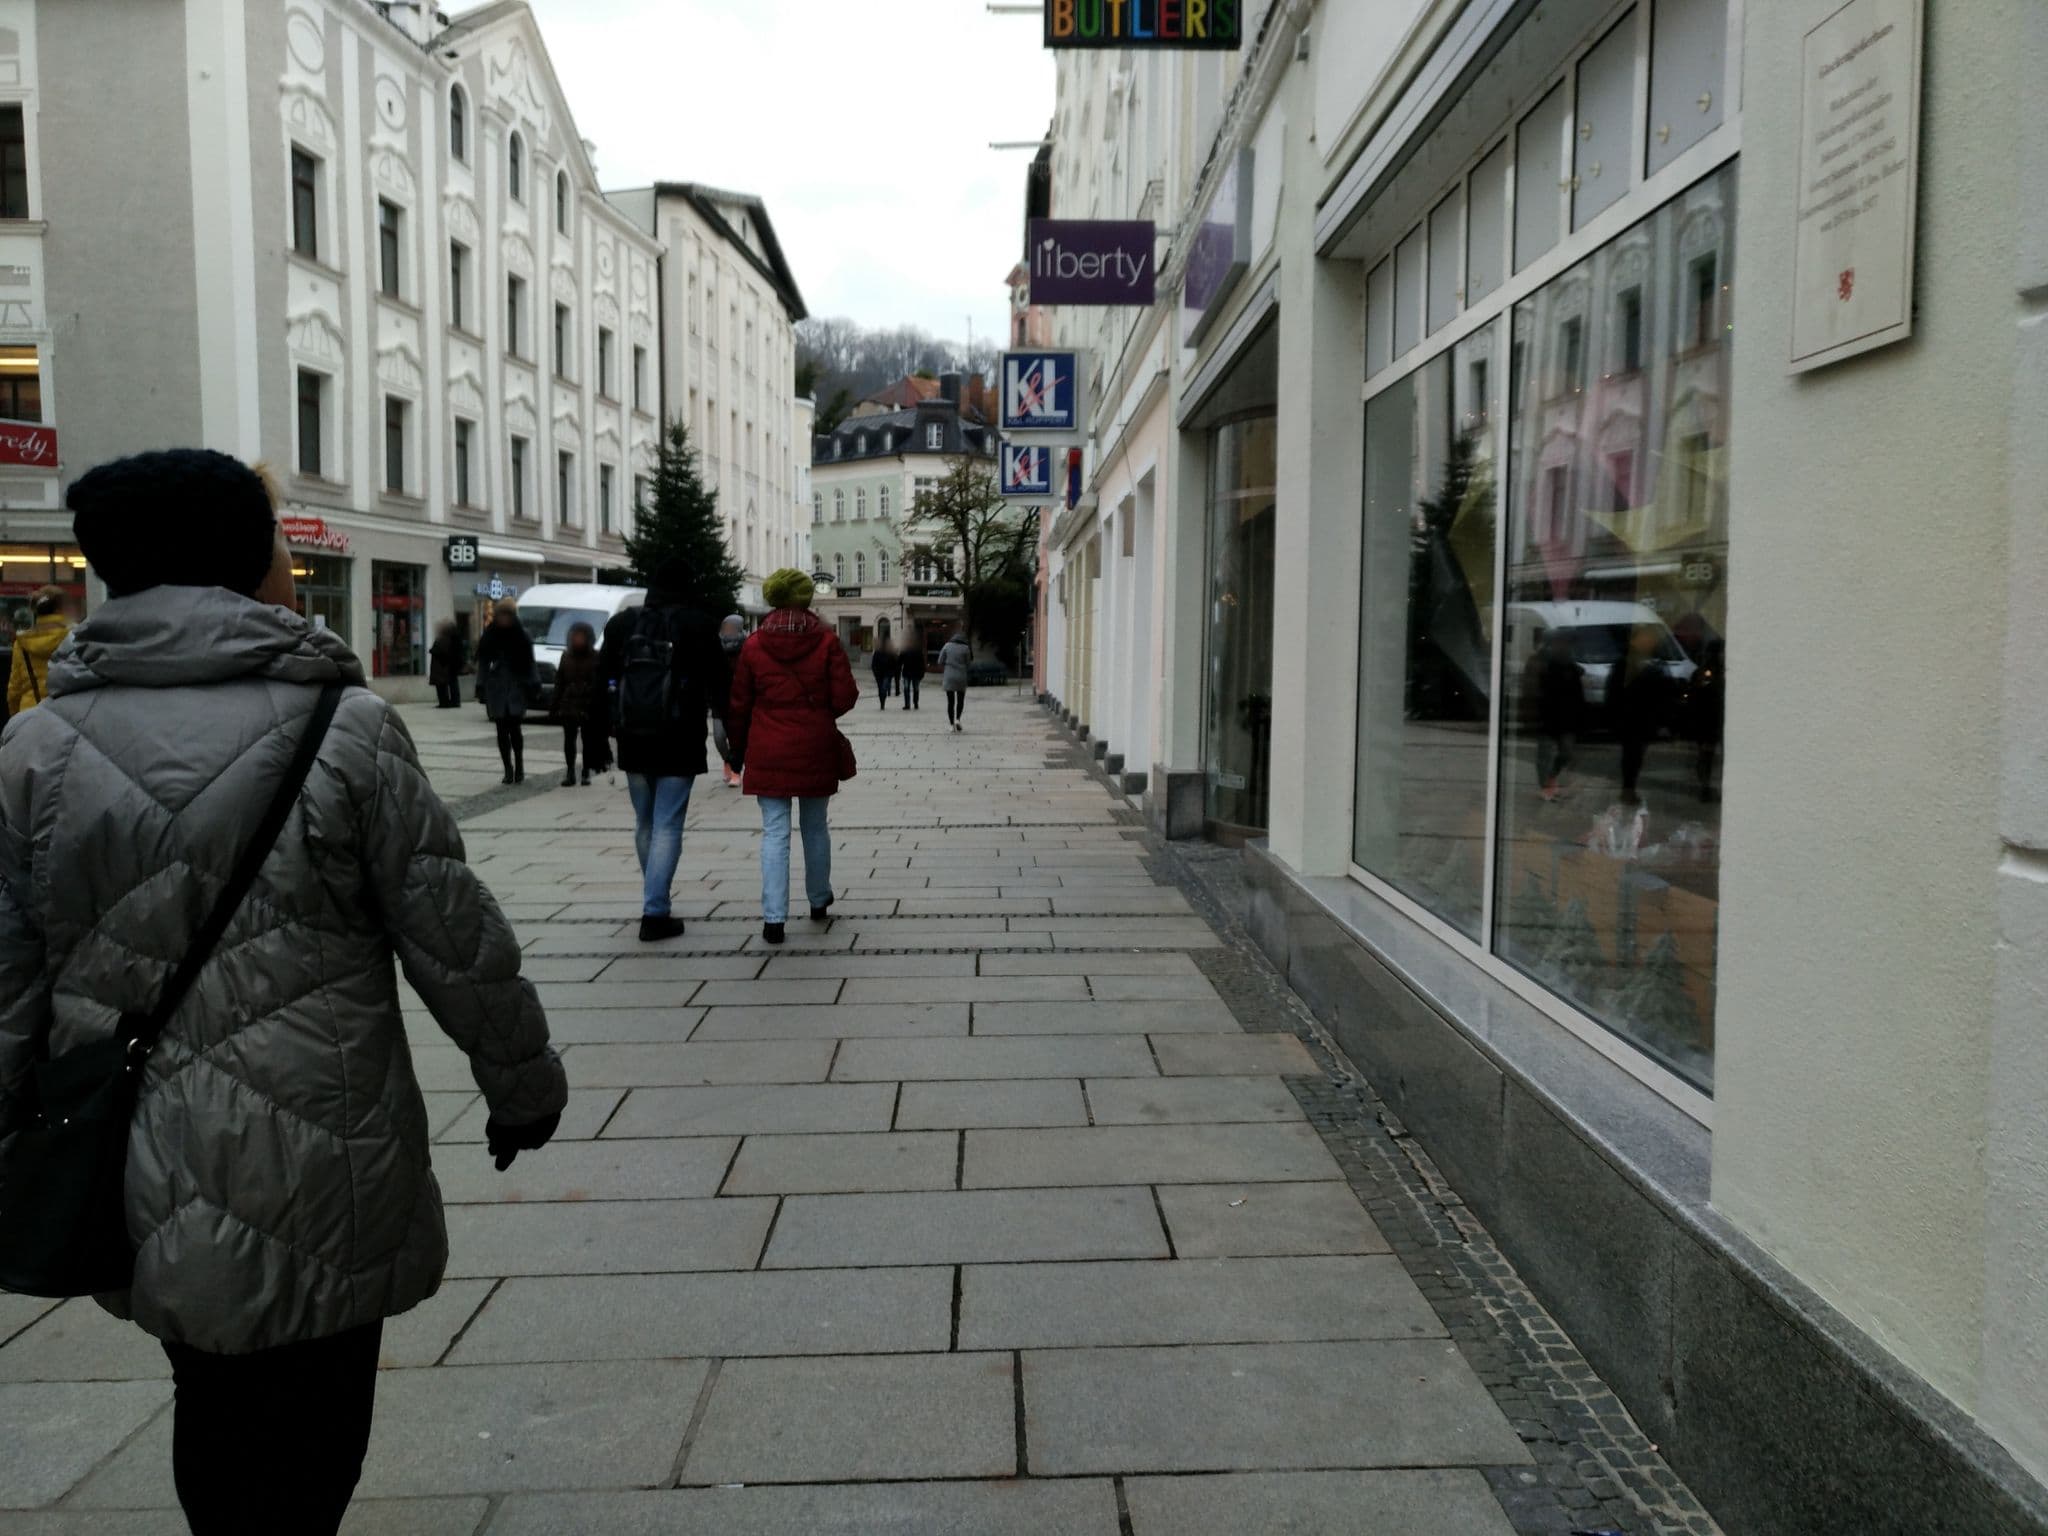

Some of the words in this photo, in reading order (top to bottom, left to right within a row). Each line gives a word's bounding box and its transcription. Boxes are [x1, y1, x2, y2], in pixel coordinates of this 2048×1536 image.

[1053, 0, 1234, 38] BUTLERS
[1037, 238, 1147, 287] liberty
[1007, 359, 1068, 418] K&L
[1005, 447, 1048, 486] K&L
